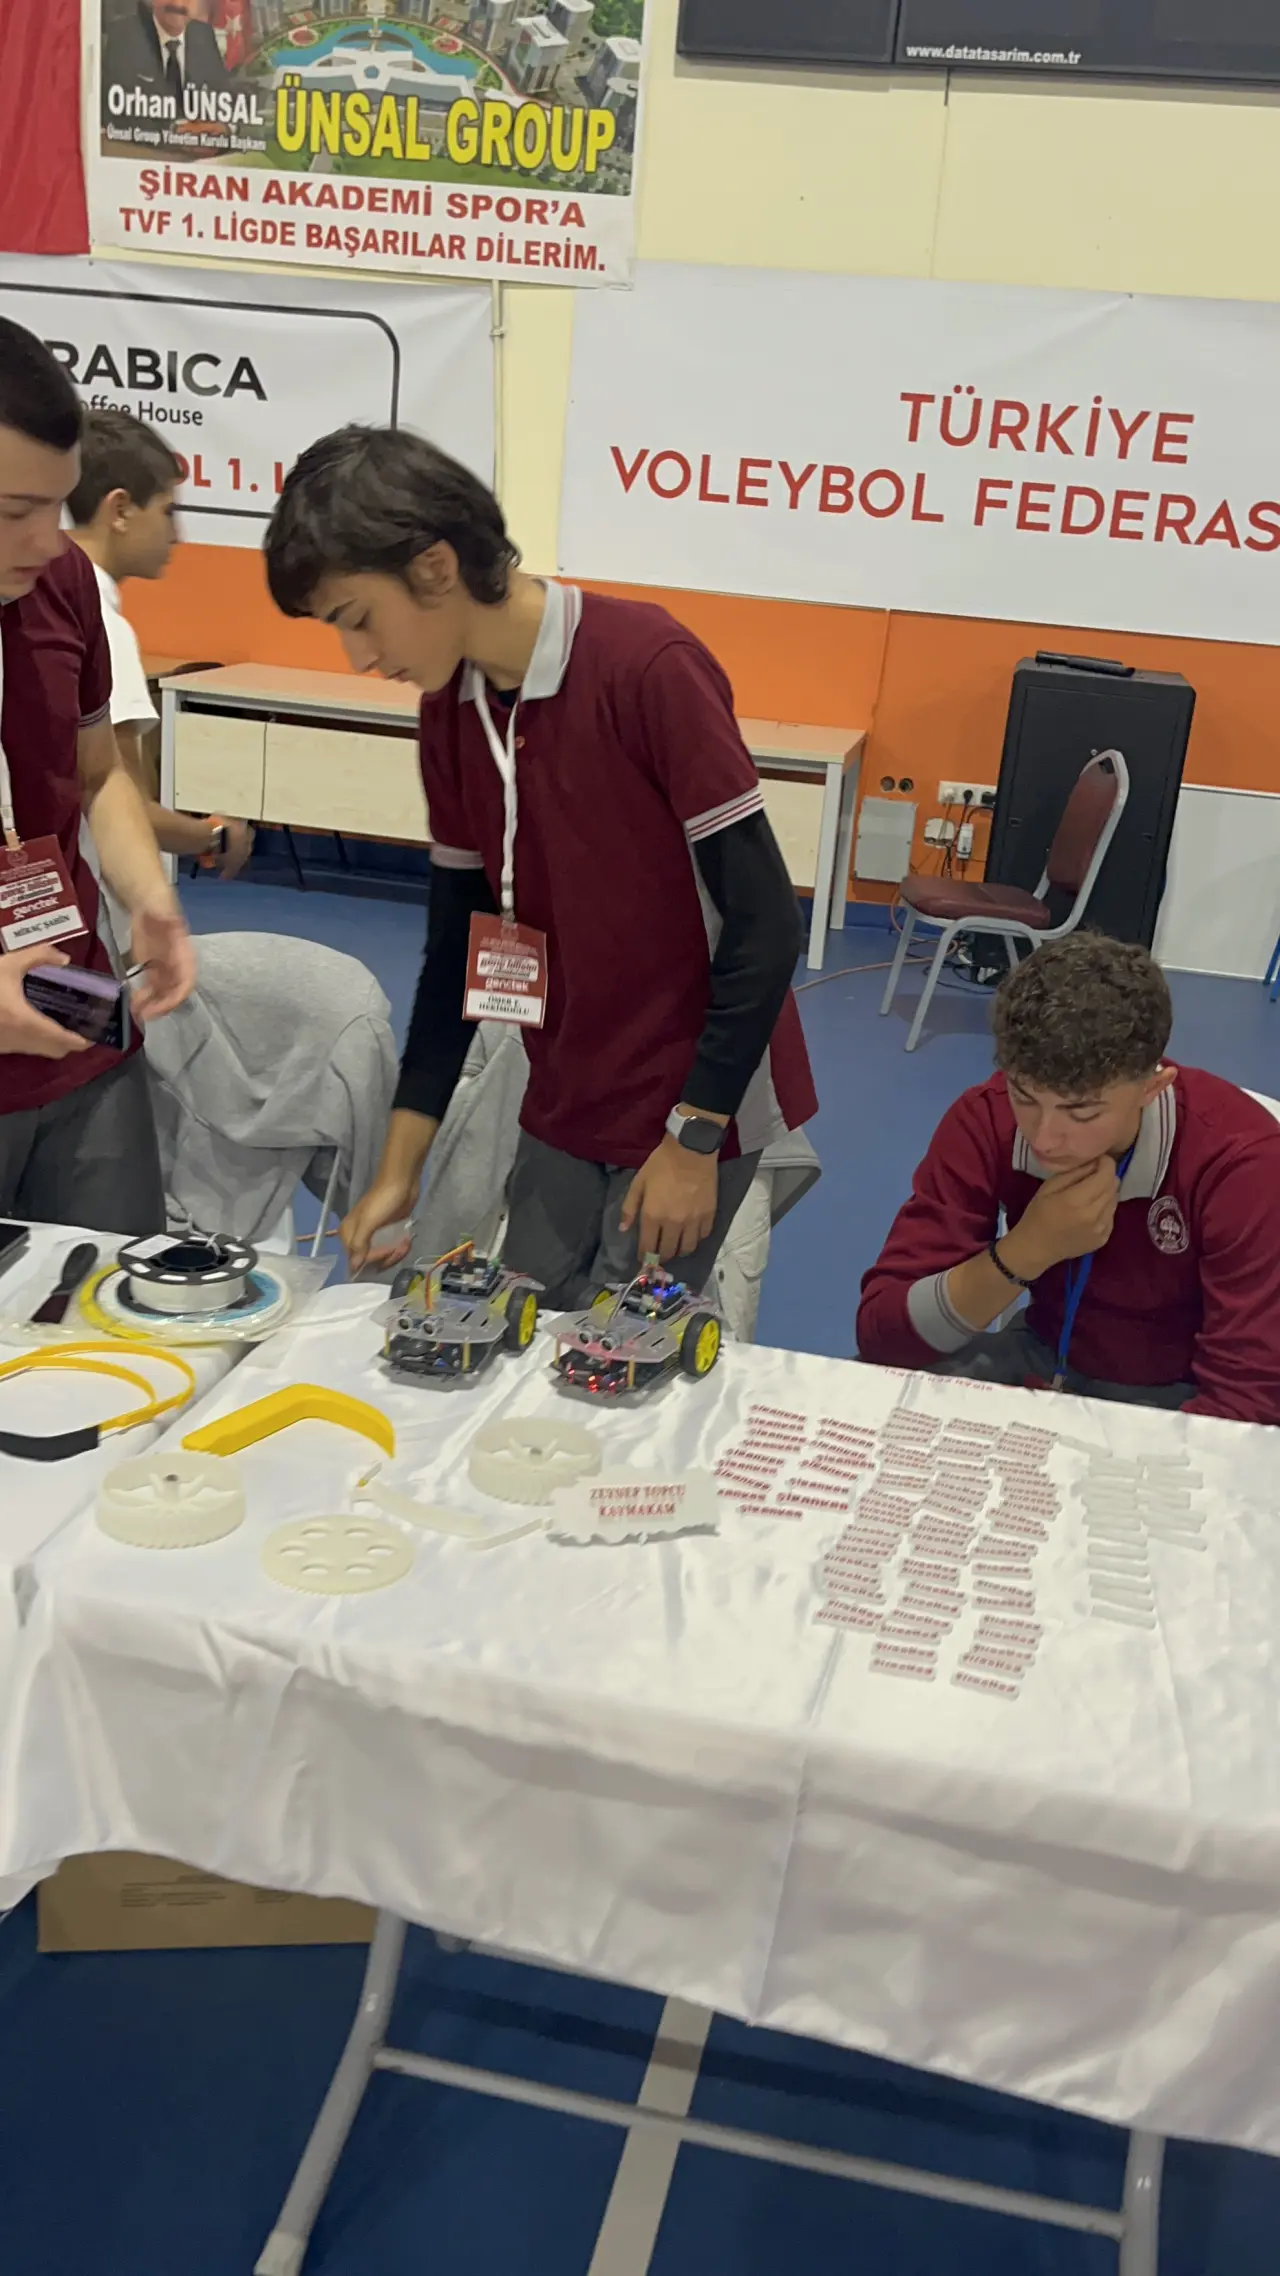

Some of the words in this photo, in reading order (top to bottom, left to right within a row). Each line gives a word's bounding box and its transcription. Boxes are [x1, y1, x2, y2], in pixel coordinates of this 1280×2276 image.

[906, 44, 1082, 65] www.datatasarim.com.tr
[108, 84, 176, 119] Orhan
[183, 83, 264, 125] ÜNSAL
[275, 75, 430, 161] ÜNSAL
[446, 98, 617, 174] GROUP
[139, 165, 249, 200] ŞİRAN
[262, 179, 432, 217] AKADEMİ
[119, 207, 171, 235] TVF
[181, 213, 204, 238] 1.
[214, 211, 296, 246] LİGDE
[306, 224, 466, 260] BAŞARILAR
[476, 232, 606, 271] DİLERİM.
[138, 401, 203, 426] House
[900, 385, 1195, 464] TÜRKİYE
[228, 458, 258, 492] 1.
[610, 446, 944, 523] VOLEYBOL
